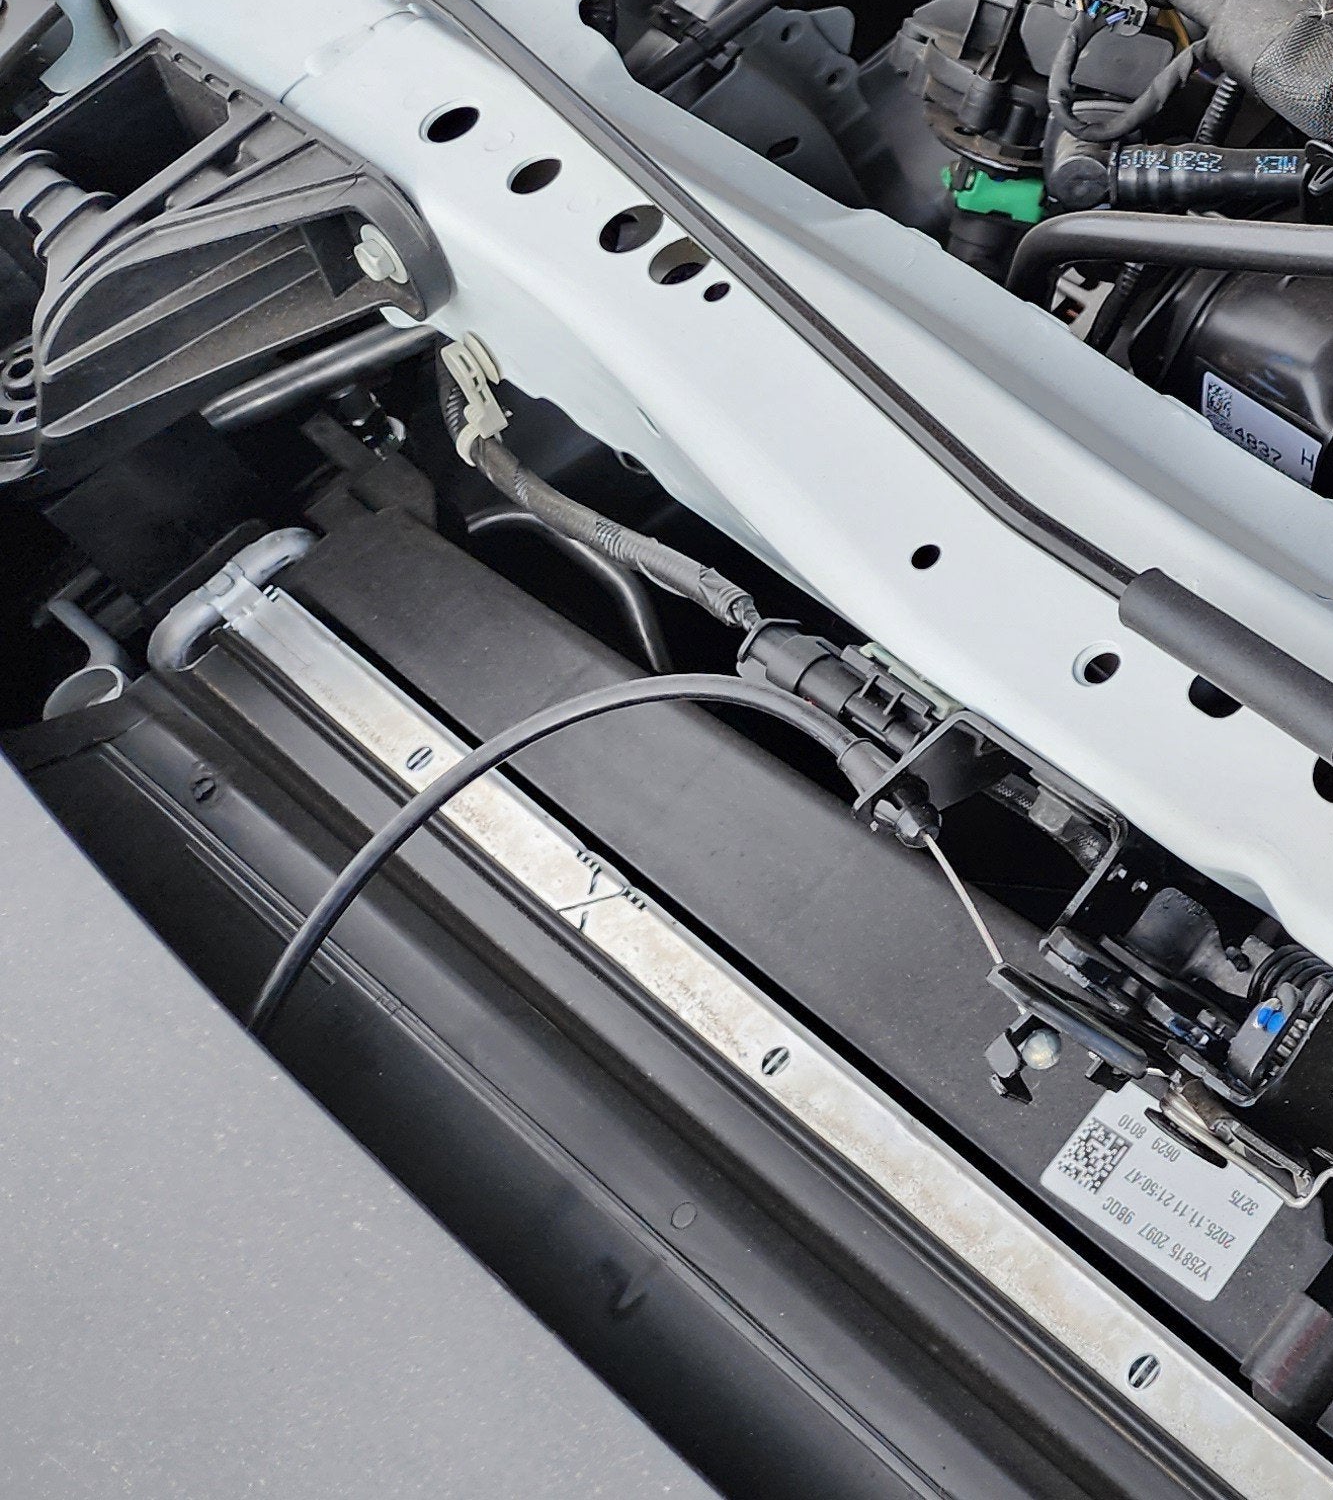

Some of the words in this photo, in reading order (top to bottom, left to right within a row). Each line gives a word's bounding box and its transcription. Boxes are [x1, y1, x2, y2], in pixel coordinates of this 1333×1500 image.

[1254, 155, 1299, 175] MEX
[1300, 447, 1315, 471] H
[1117, 1113, 1148, 1140] 8010
[1151, 1136, 1181, 1163] 0629
[1123, 1167, 1176, 1207] 21:50:47
[1228, 1189, 1259, 1217] 3275
[1137, 1222, 1171, 1249] 2097
[1172, 1201, 1237, 1250] 2025.11.11
[1170, 1243, 1213, 1282] Y25815
